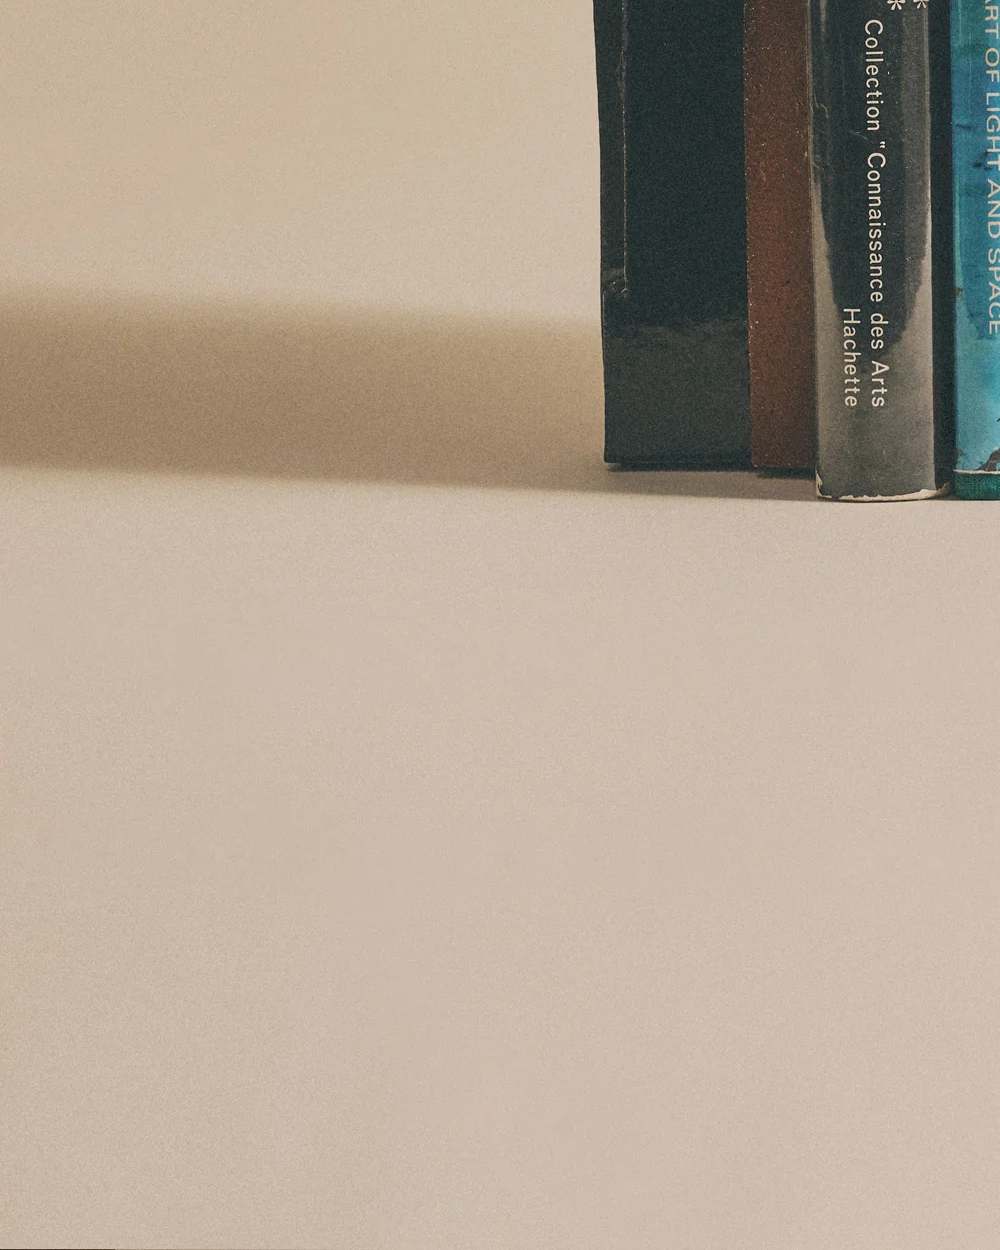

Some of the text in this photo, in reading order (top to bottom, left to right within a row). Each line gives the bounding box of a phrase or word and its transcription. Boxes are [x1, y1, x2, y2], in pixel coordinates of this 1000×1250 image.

[864, 19, 884, 131] Collection
[984, 47, 1000, 83] OF
[985, 91, 1000, 171] LIGHT
[843, 307, 861, 407] Hachette
[870, 311, 889, 349] des
[871, 360, 889, 408] Arts
